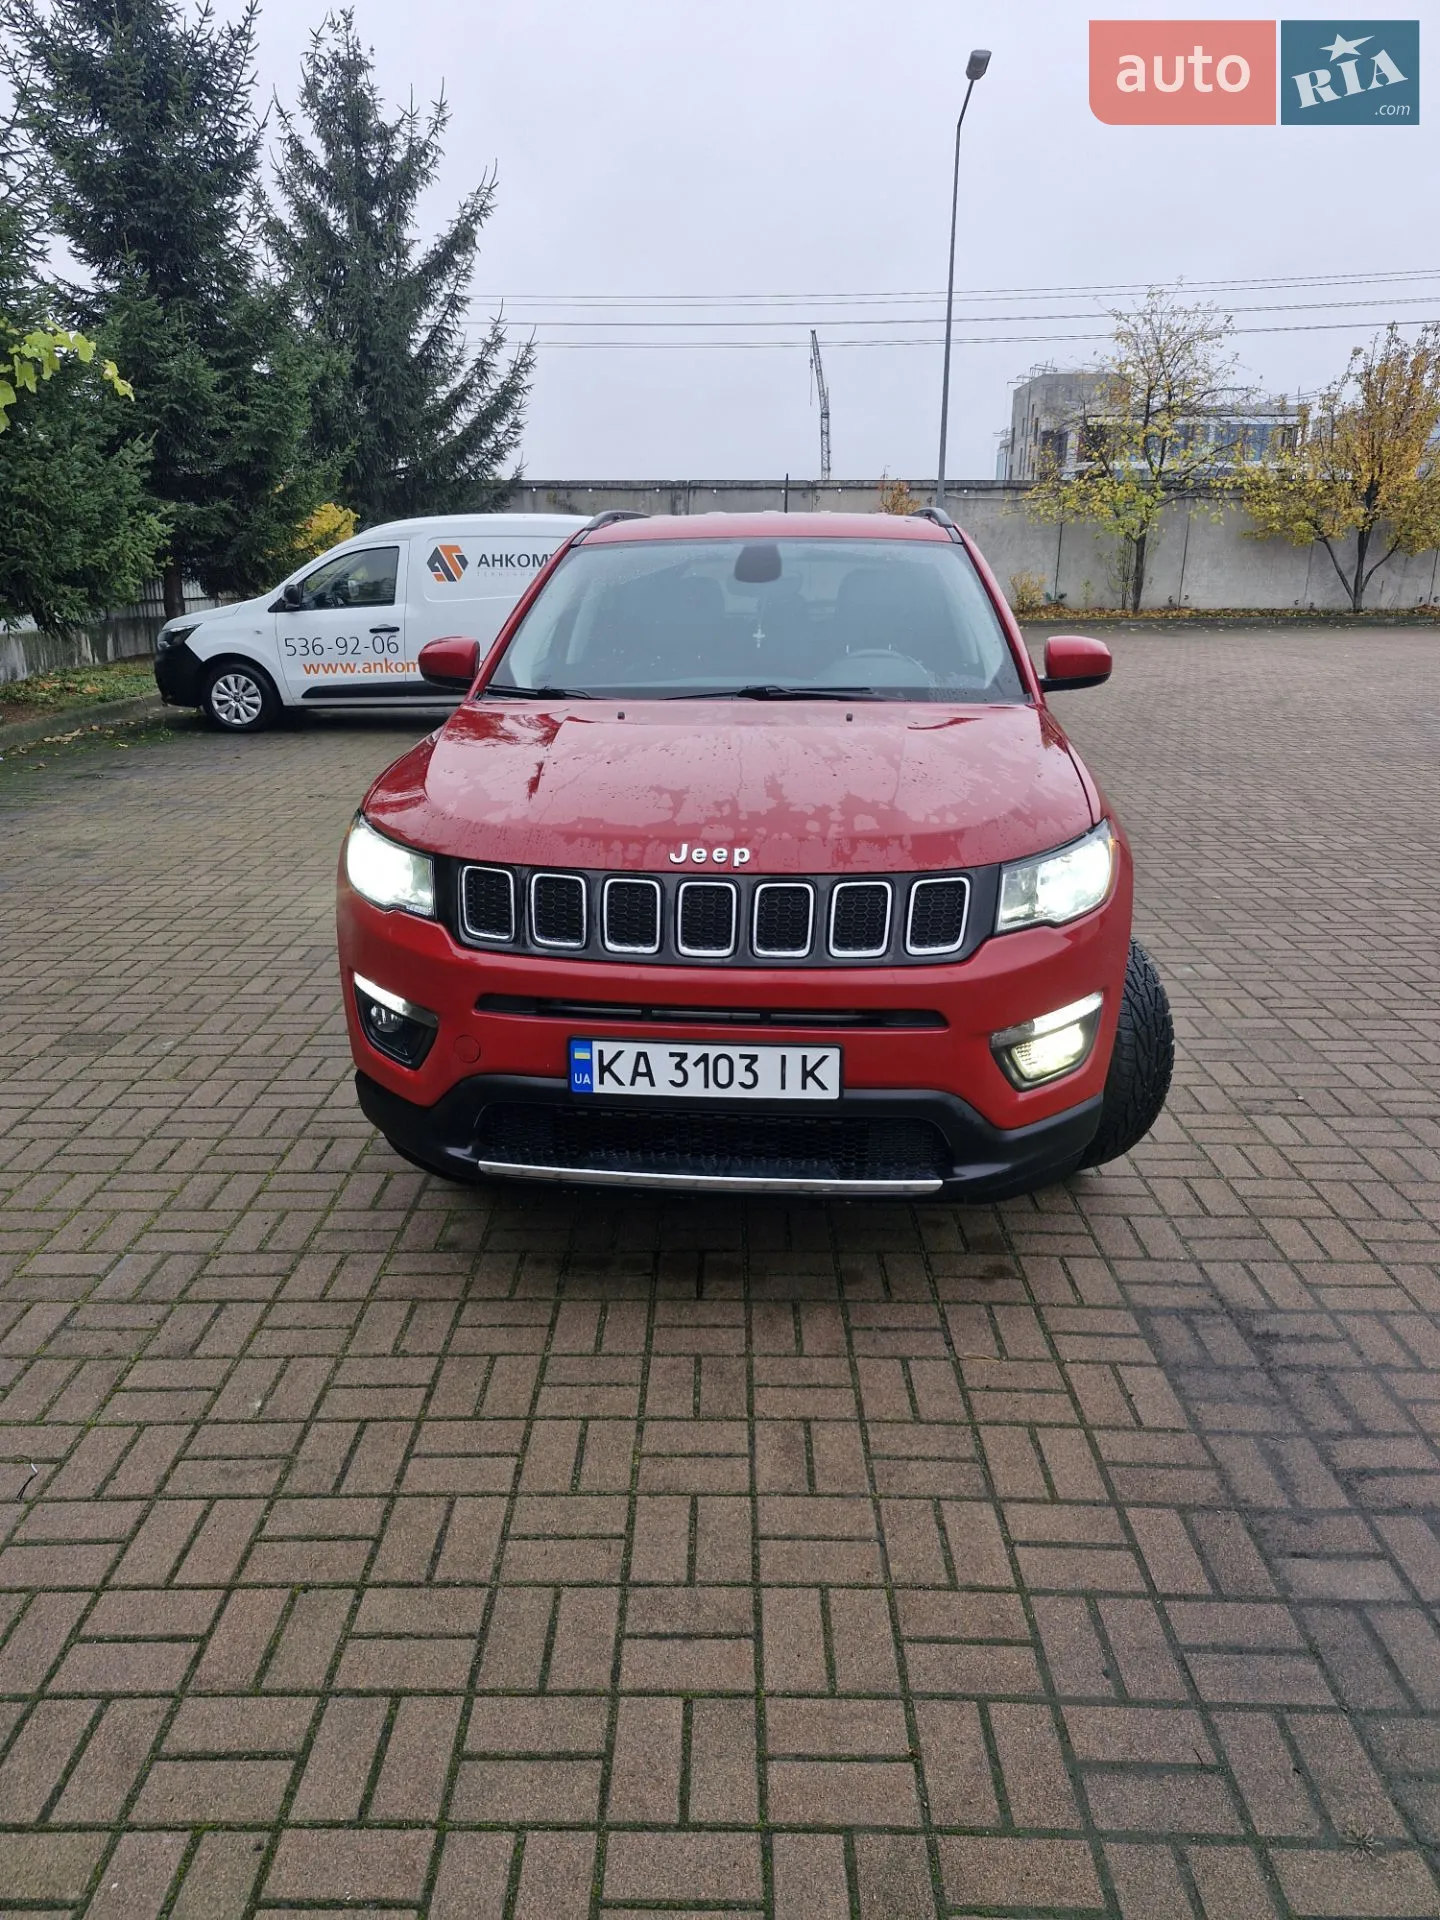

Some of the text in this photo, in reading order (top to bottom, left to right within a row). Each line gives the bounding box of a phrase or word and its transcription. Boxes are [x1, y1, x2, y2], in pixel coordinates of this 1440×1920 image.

[477, 553, 554, 568] АНКОМ
[284, 635, 400, 656] 536-92-06
[669, 843, 751, 868] Jeep
[574, 1072, 591, 1085] UA
[597, 1049, 830, 1091] KA 3103 IK
